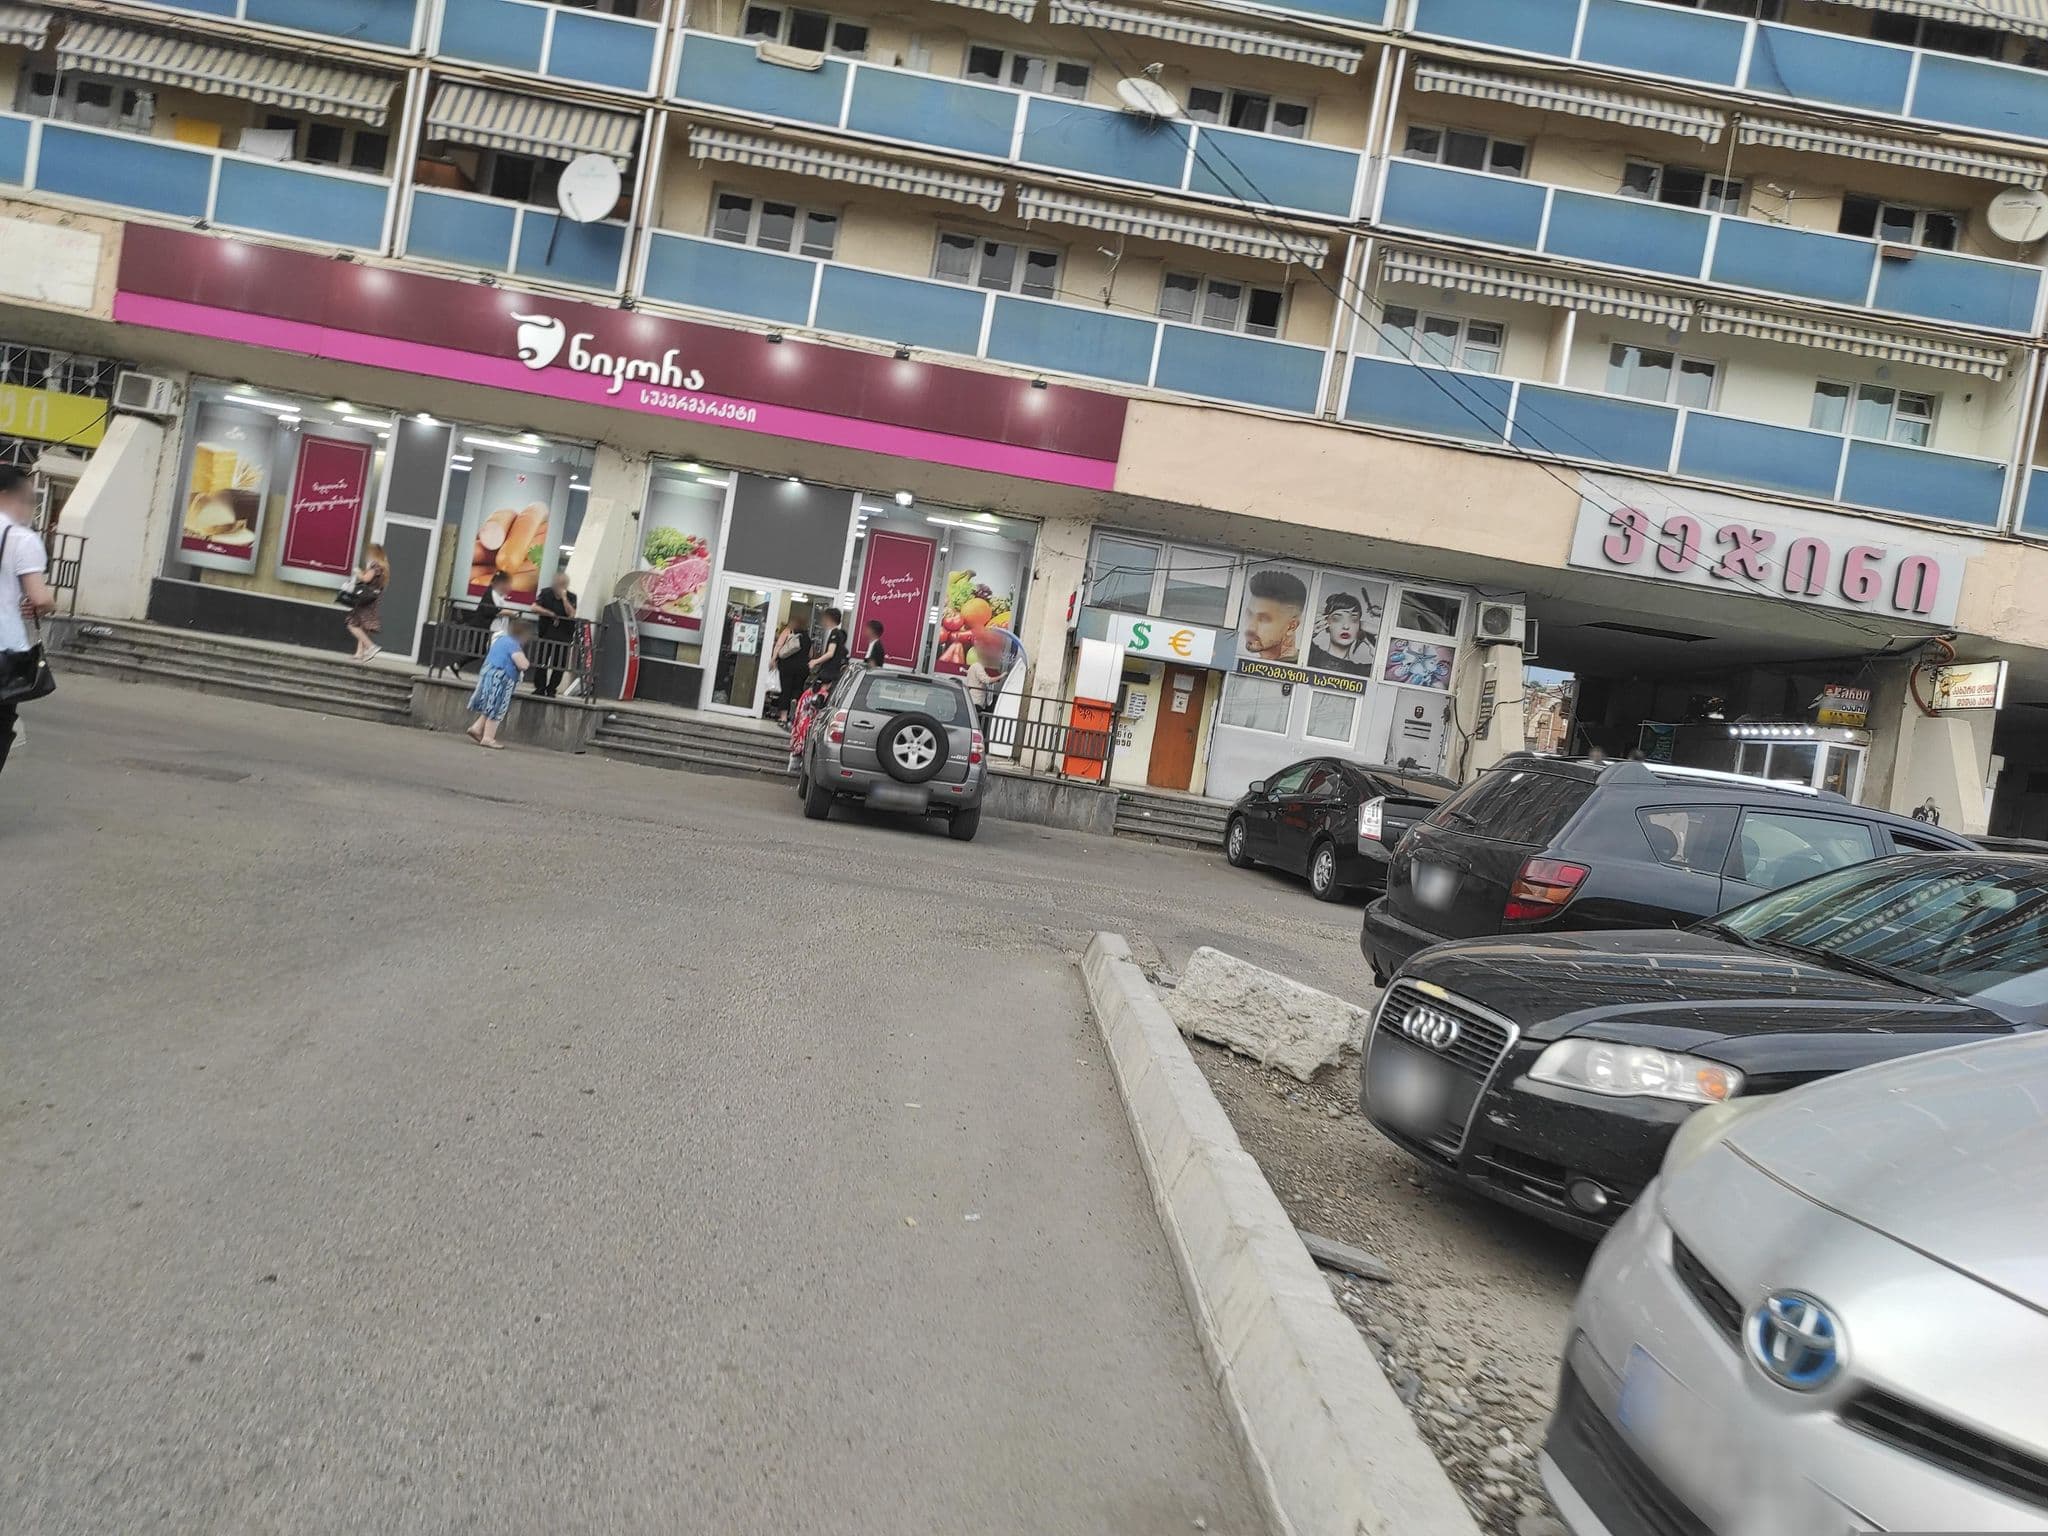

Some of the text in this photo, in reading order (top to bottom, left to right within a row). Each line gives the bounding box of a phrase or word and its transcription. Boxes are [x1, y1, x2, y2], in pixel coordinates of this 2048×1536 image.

[569, 333, 705, 395] ნიკორა
[640, 389, 757, 423] სუპერმარკეტი
[1602, 505, 1941, 615] ვეჯინი
[1240, 661, 1363, 693] სილამაზის სალონი
